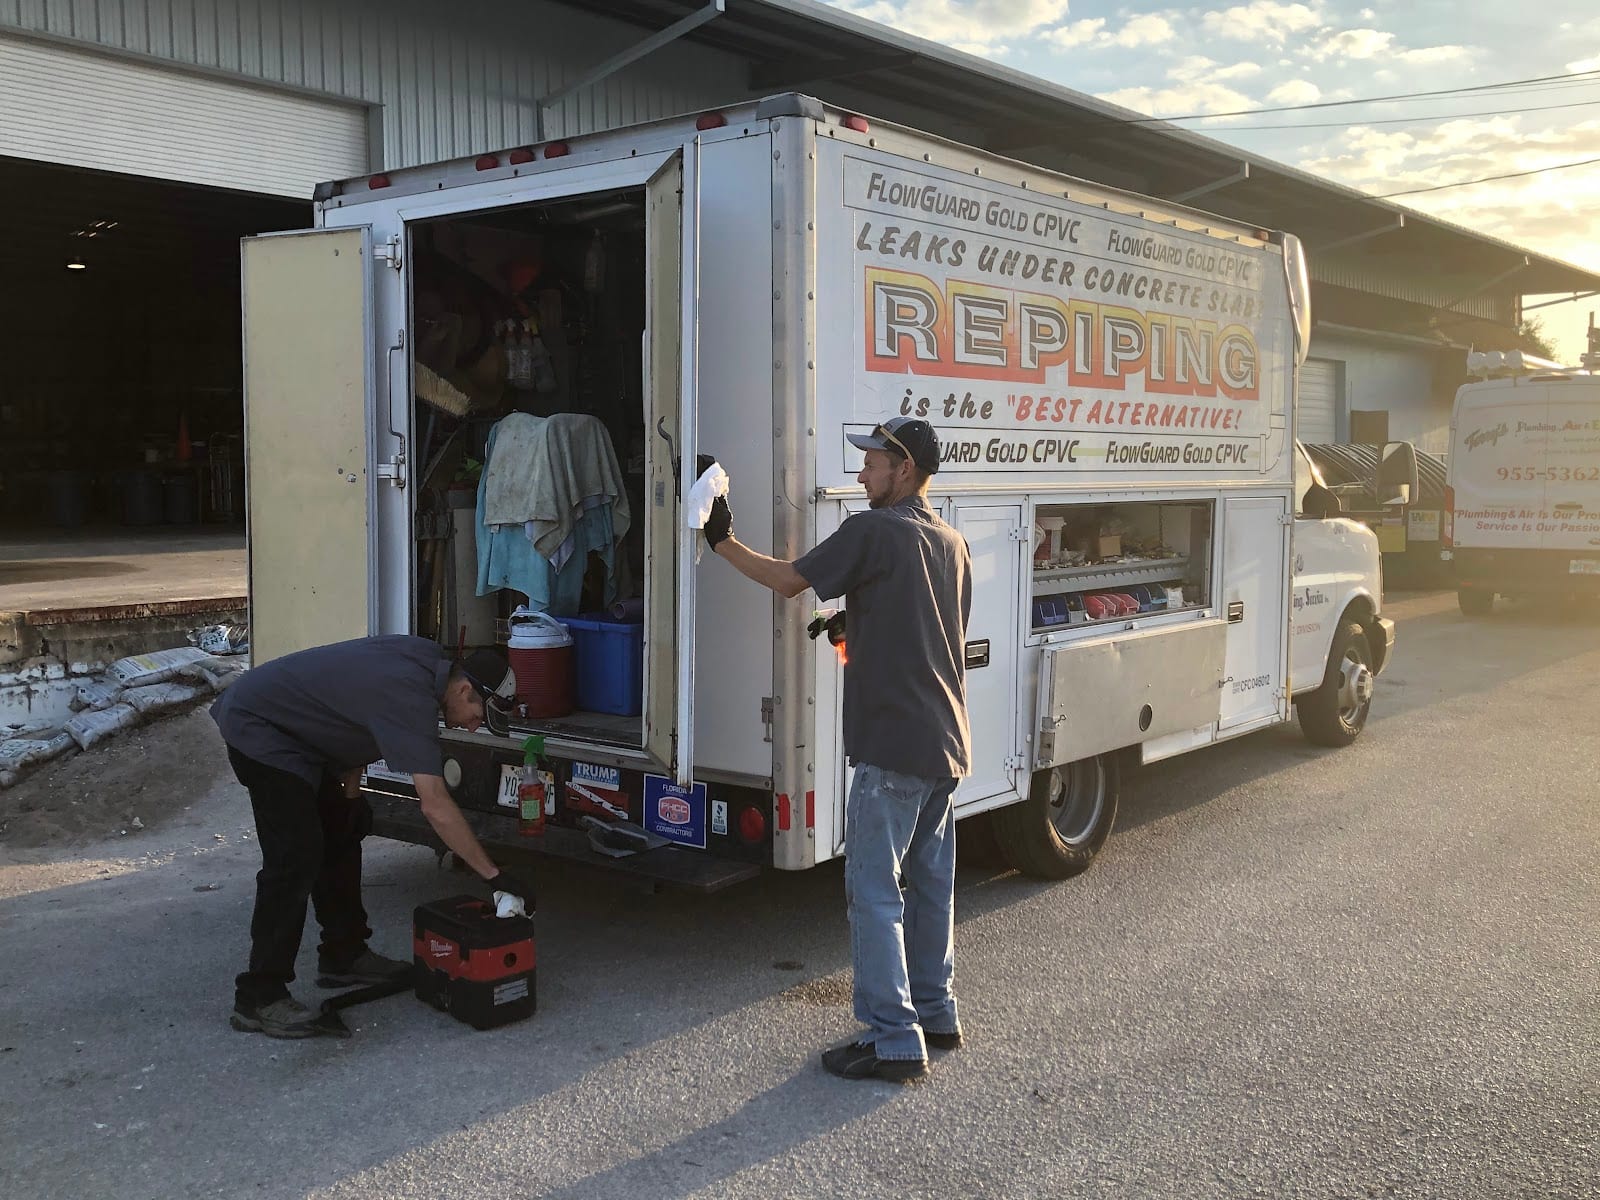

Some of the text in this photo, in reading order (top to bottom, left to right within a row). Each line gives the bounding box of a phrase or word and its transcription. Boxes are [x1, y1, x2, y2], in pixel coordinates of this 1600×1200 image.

[1033, 212, 1081, 244] CPVC
[856, 222, 967, 267] LEAKS
[978, 245, 1075, 286] UNDER
[1084, 265, 1203, 308] CONCRETE
[1217, 255, 1252, 281] CPVC
[872, 279, 1257, 390] REPIPING
[899, 388, 930, 417] is
[943, 391, 994, 420] the
[1086, 399, 1242, 430] ALTERNATIVE!
[1032, 439, 1080, 463] CPVC
[1215, 444, 1249, 464] CPVC
[1496, 466, 1600, 482] 955-5362
[1518, 509, 1535, 519] Air
[1552, 510, 1574, 520] Our
[1475, 520, 1519, 532] Service
[1536, 522, 1558, 532] Our
[1560, 522, 1600, 533] Passio
[575, 761, 618, 781] TRUMP
[662, 783, 688, 794] FLORIDA
[661, 801, 688, 814] PHCC
